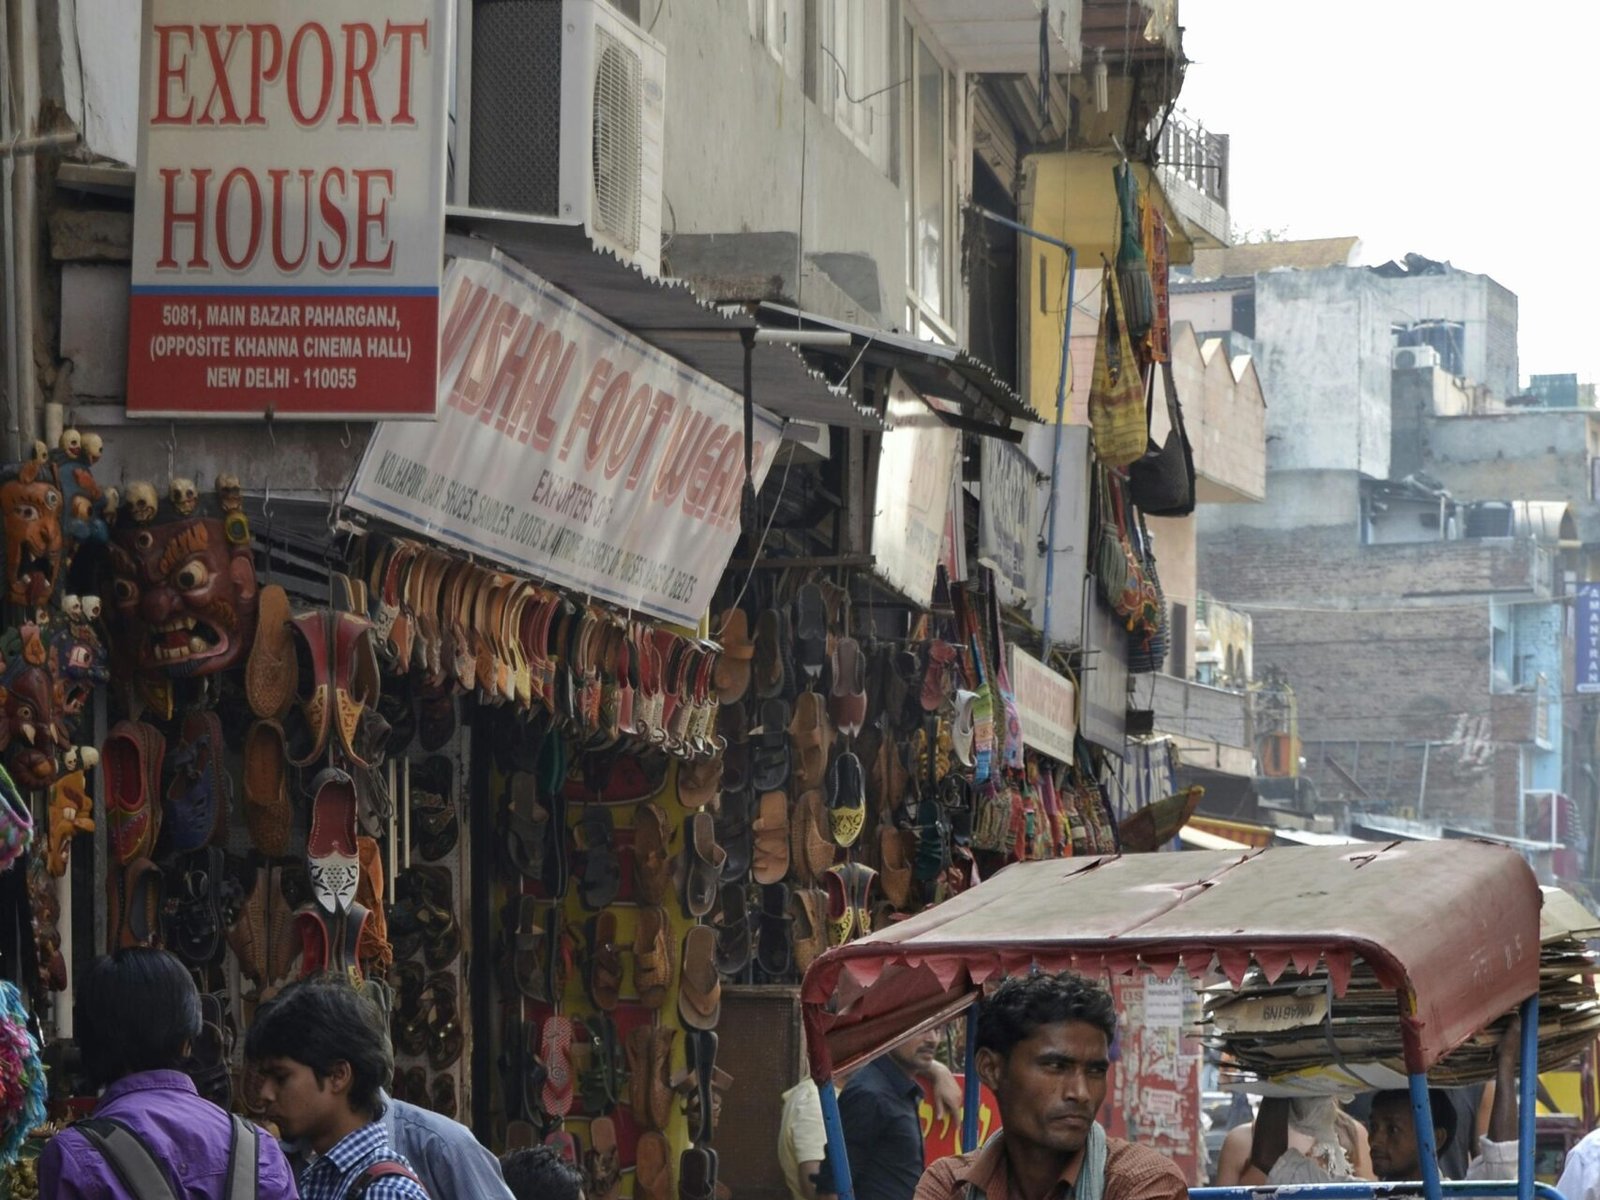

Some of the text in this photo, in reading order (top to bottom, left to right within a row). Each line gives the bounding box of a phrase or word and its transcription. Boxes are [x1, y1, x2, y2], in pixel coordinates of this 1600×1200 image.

[150, 19, 428, 126] EXPORT
[156, 166, 395, 272] HOUSE
[163, 305, 400, 331] 5081, MAIN BAZAR PAHARGANJ,
[151, 336, 411, 363] (OPPOSITE KHANNA CINEMA HALL)
[440, 276, 576, 453] VISHAL
[207, 367, 241, 388] NEW
[245, 367, 289, 388] DELHI
[304, 368, 356, 389] 110055
[532, 469, 598, 524] EXPORTERS
[541, 524, 554, 551] &
[1588, 588, 1600, 682] AMANTRAN
[1148, 974, 1181, 986] BDY
